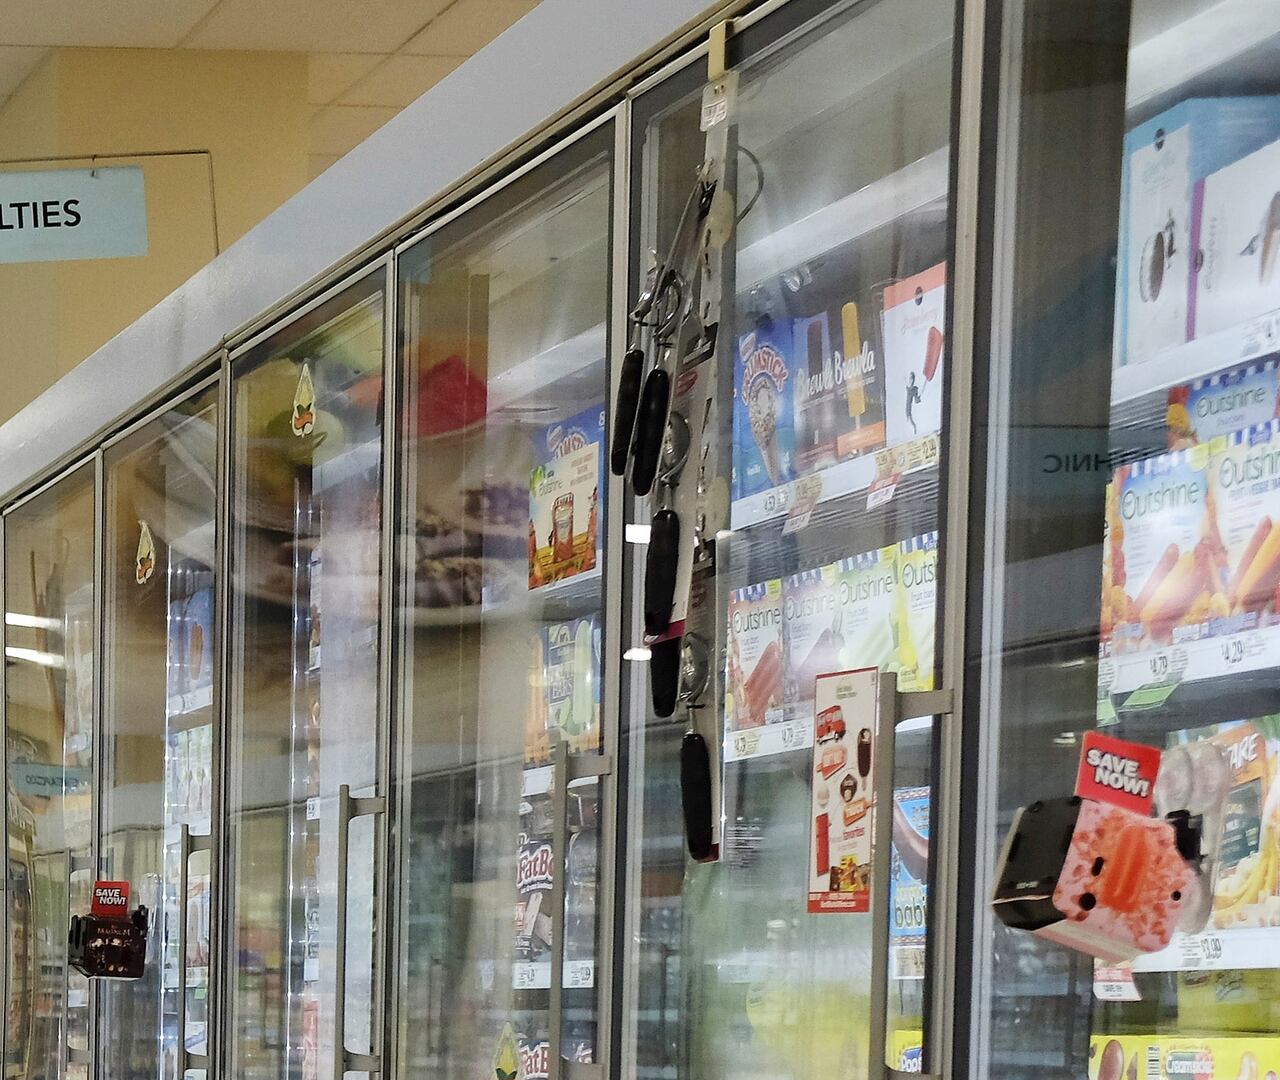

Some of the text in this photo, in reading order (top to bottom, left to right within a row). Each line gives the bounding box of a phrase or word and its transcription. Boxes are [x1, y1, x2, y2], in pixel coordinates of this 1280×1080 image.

[1196, 384, 1267, 418] Outshine
[1120, 481, 1200, 520] Outshine
[840, 574, 892, 606] Outshine
[732, 606, 782, 634] Outshine
[1086, 748, 1139, 777] SAVE
[1095, 769, 1150, 798] NOW!
[96, 888, 120, 897] SAVE
[99, 896, 126, 905] NOW!
